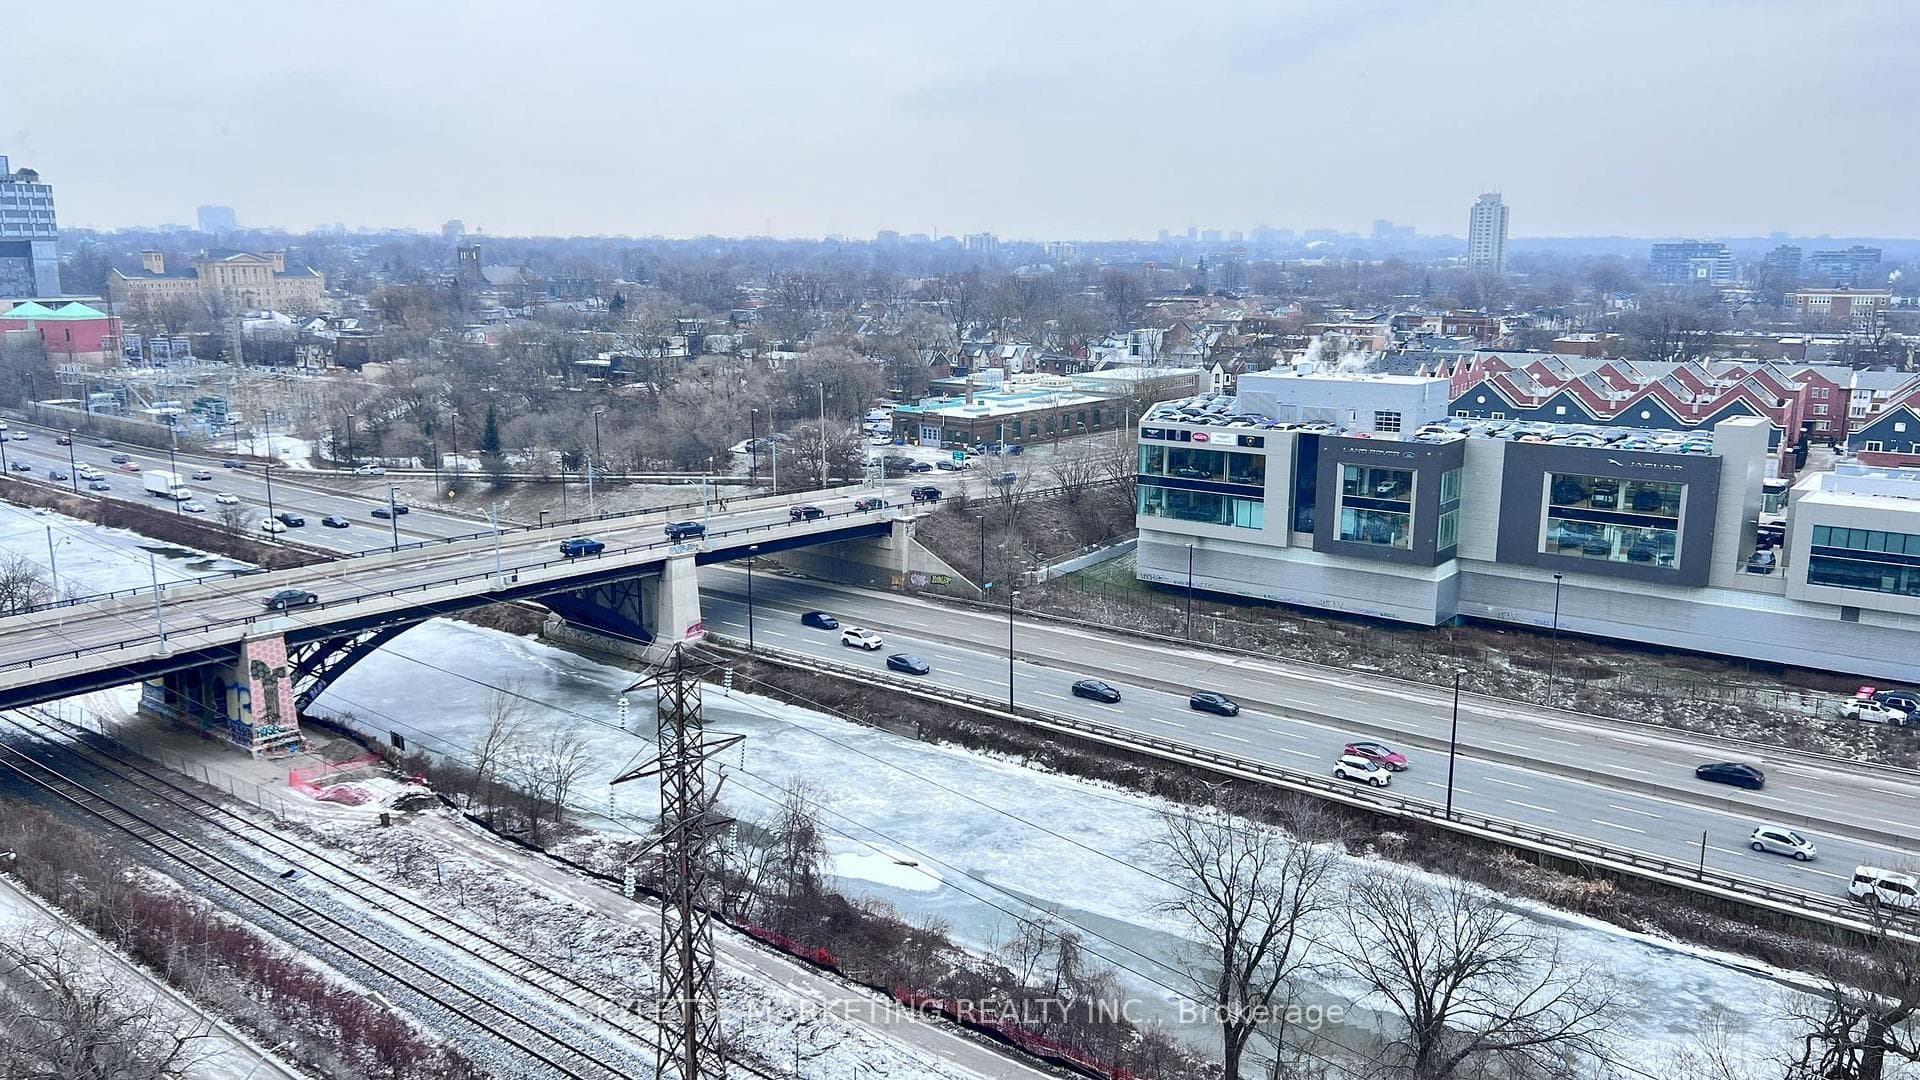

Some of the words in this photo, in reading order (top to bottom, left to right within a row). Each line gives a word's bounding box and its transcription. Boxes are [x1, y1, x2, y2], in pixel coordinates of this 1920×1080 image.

[1343, 447, 1367, 455] LAND
[1369, 449, 1400, 457] ROVER
[1629, 461, 1683, 471] JAGUAR
